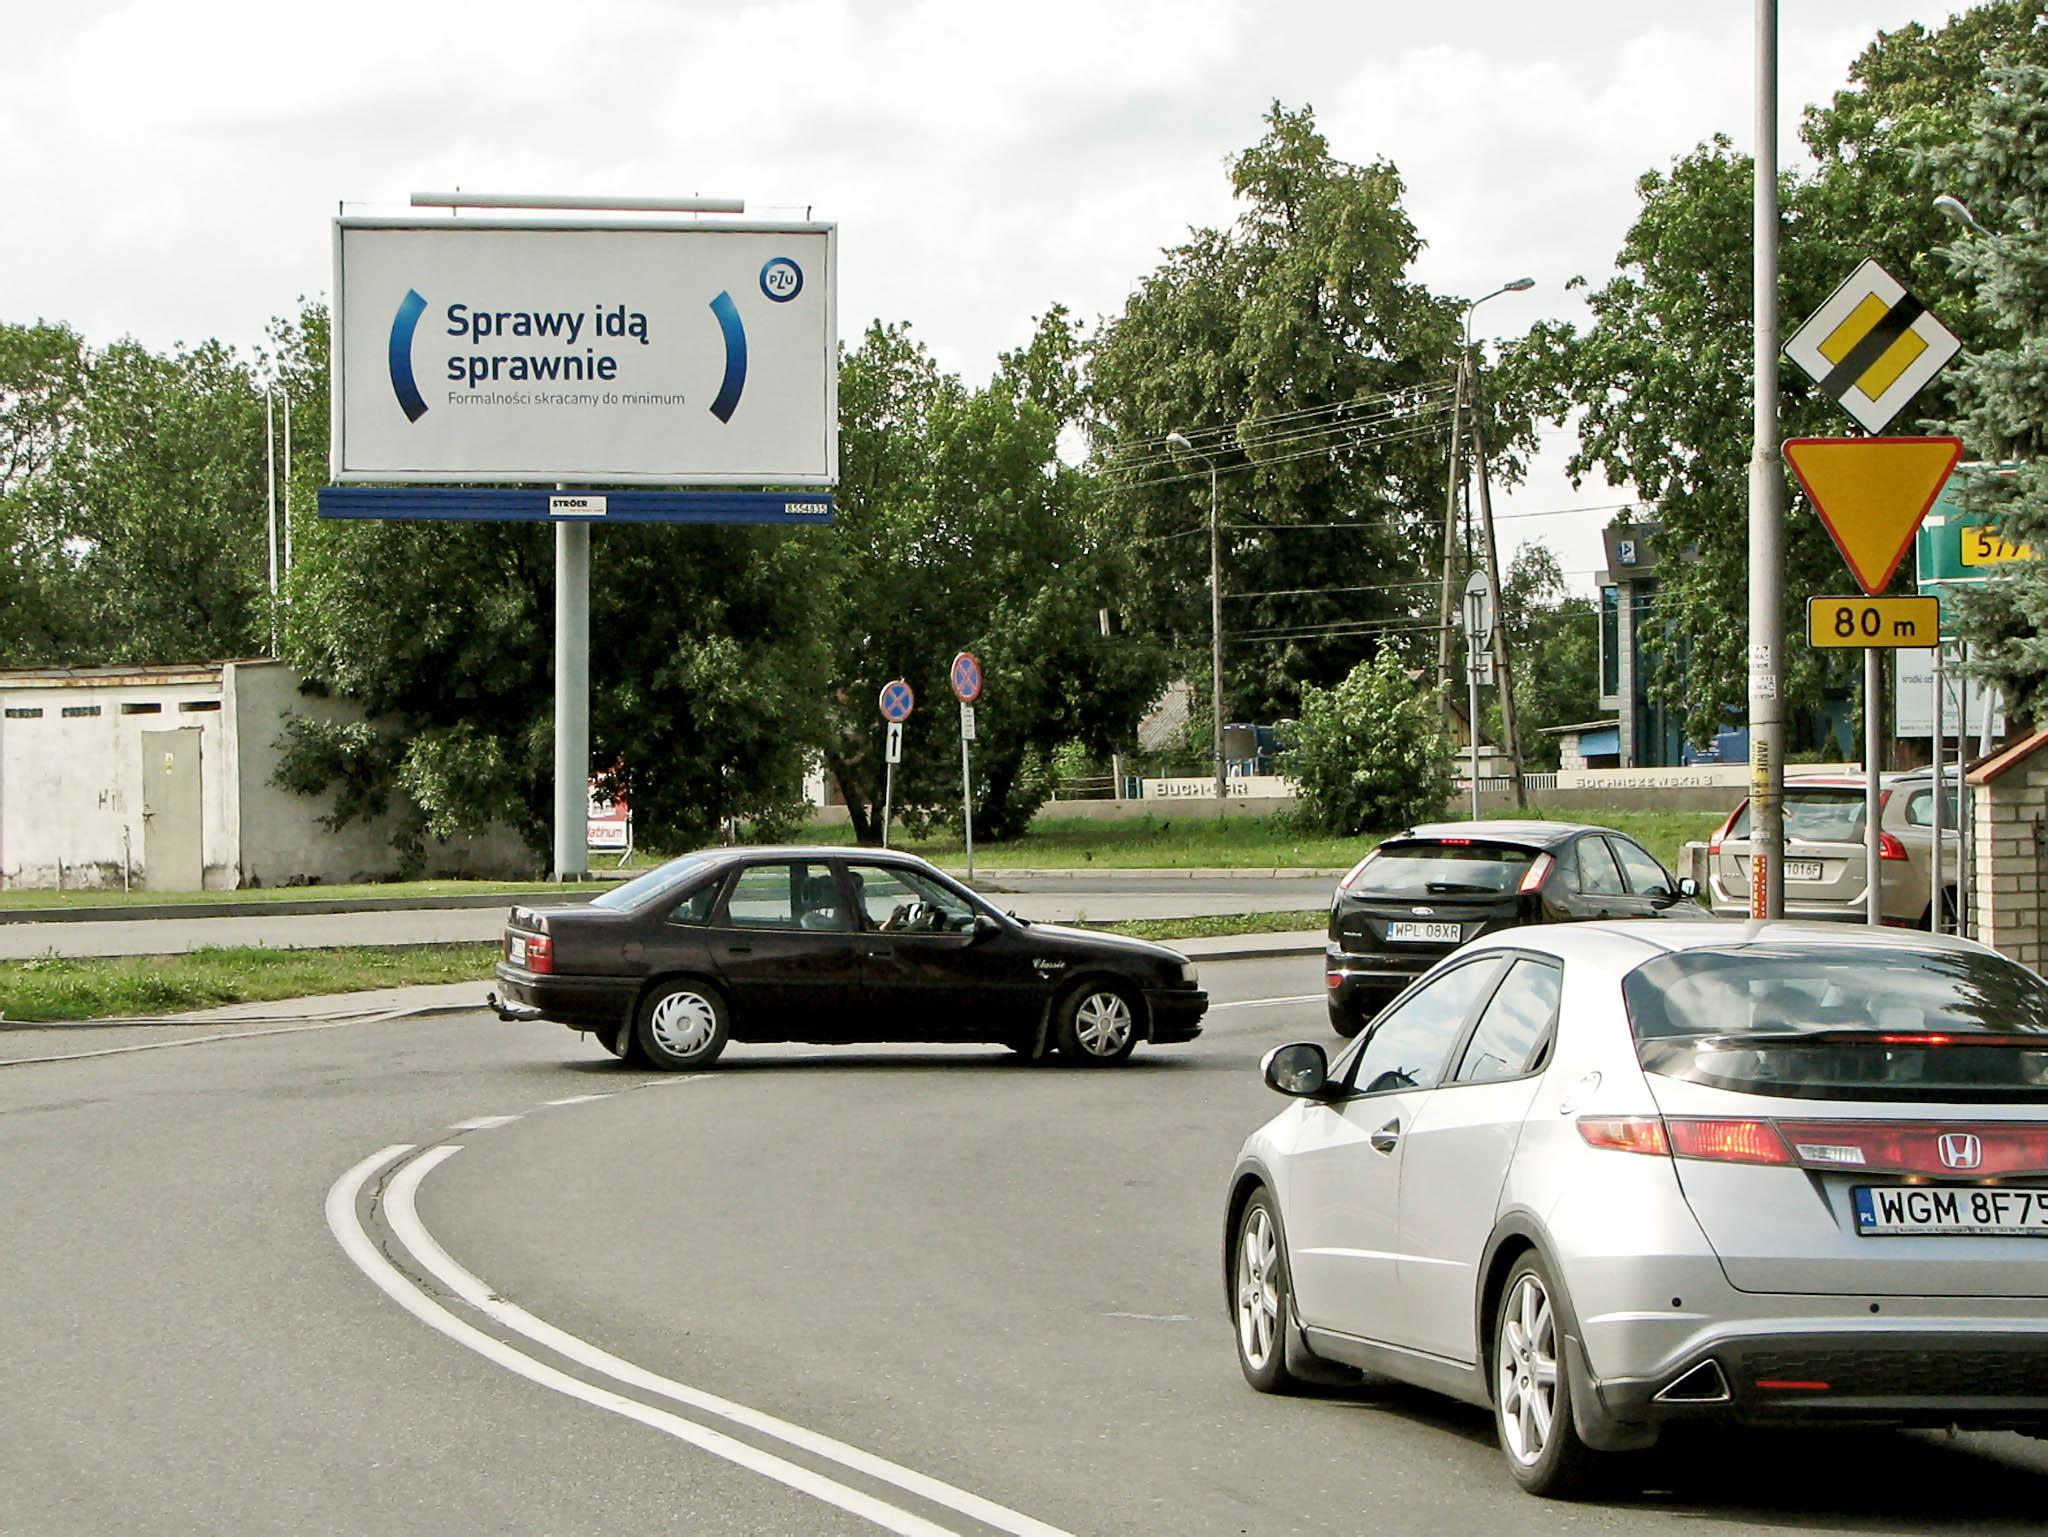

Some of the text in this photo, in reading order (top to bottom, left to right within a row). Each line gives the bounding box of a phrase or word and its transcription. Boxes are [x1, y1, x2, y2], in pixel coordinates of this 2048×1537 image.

[769, 270, 793, 290] PZU
[447, 304, 650, 345] Sprawy idą
[447, 348, 618, 389] sprawnie
[448, 391, 686, 407] Formalności skracamy do minimum
[1834, 606, 1916, 638] 80 m
[1395, 923, 1459, 939] WPL 08XR
[1860, 1212, 1874, 1222] PL
[1879, 1191, 1961, 1224] WGM
